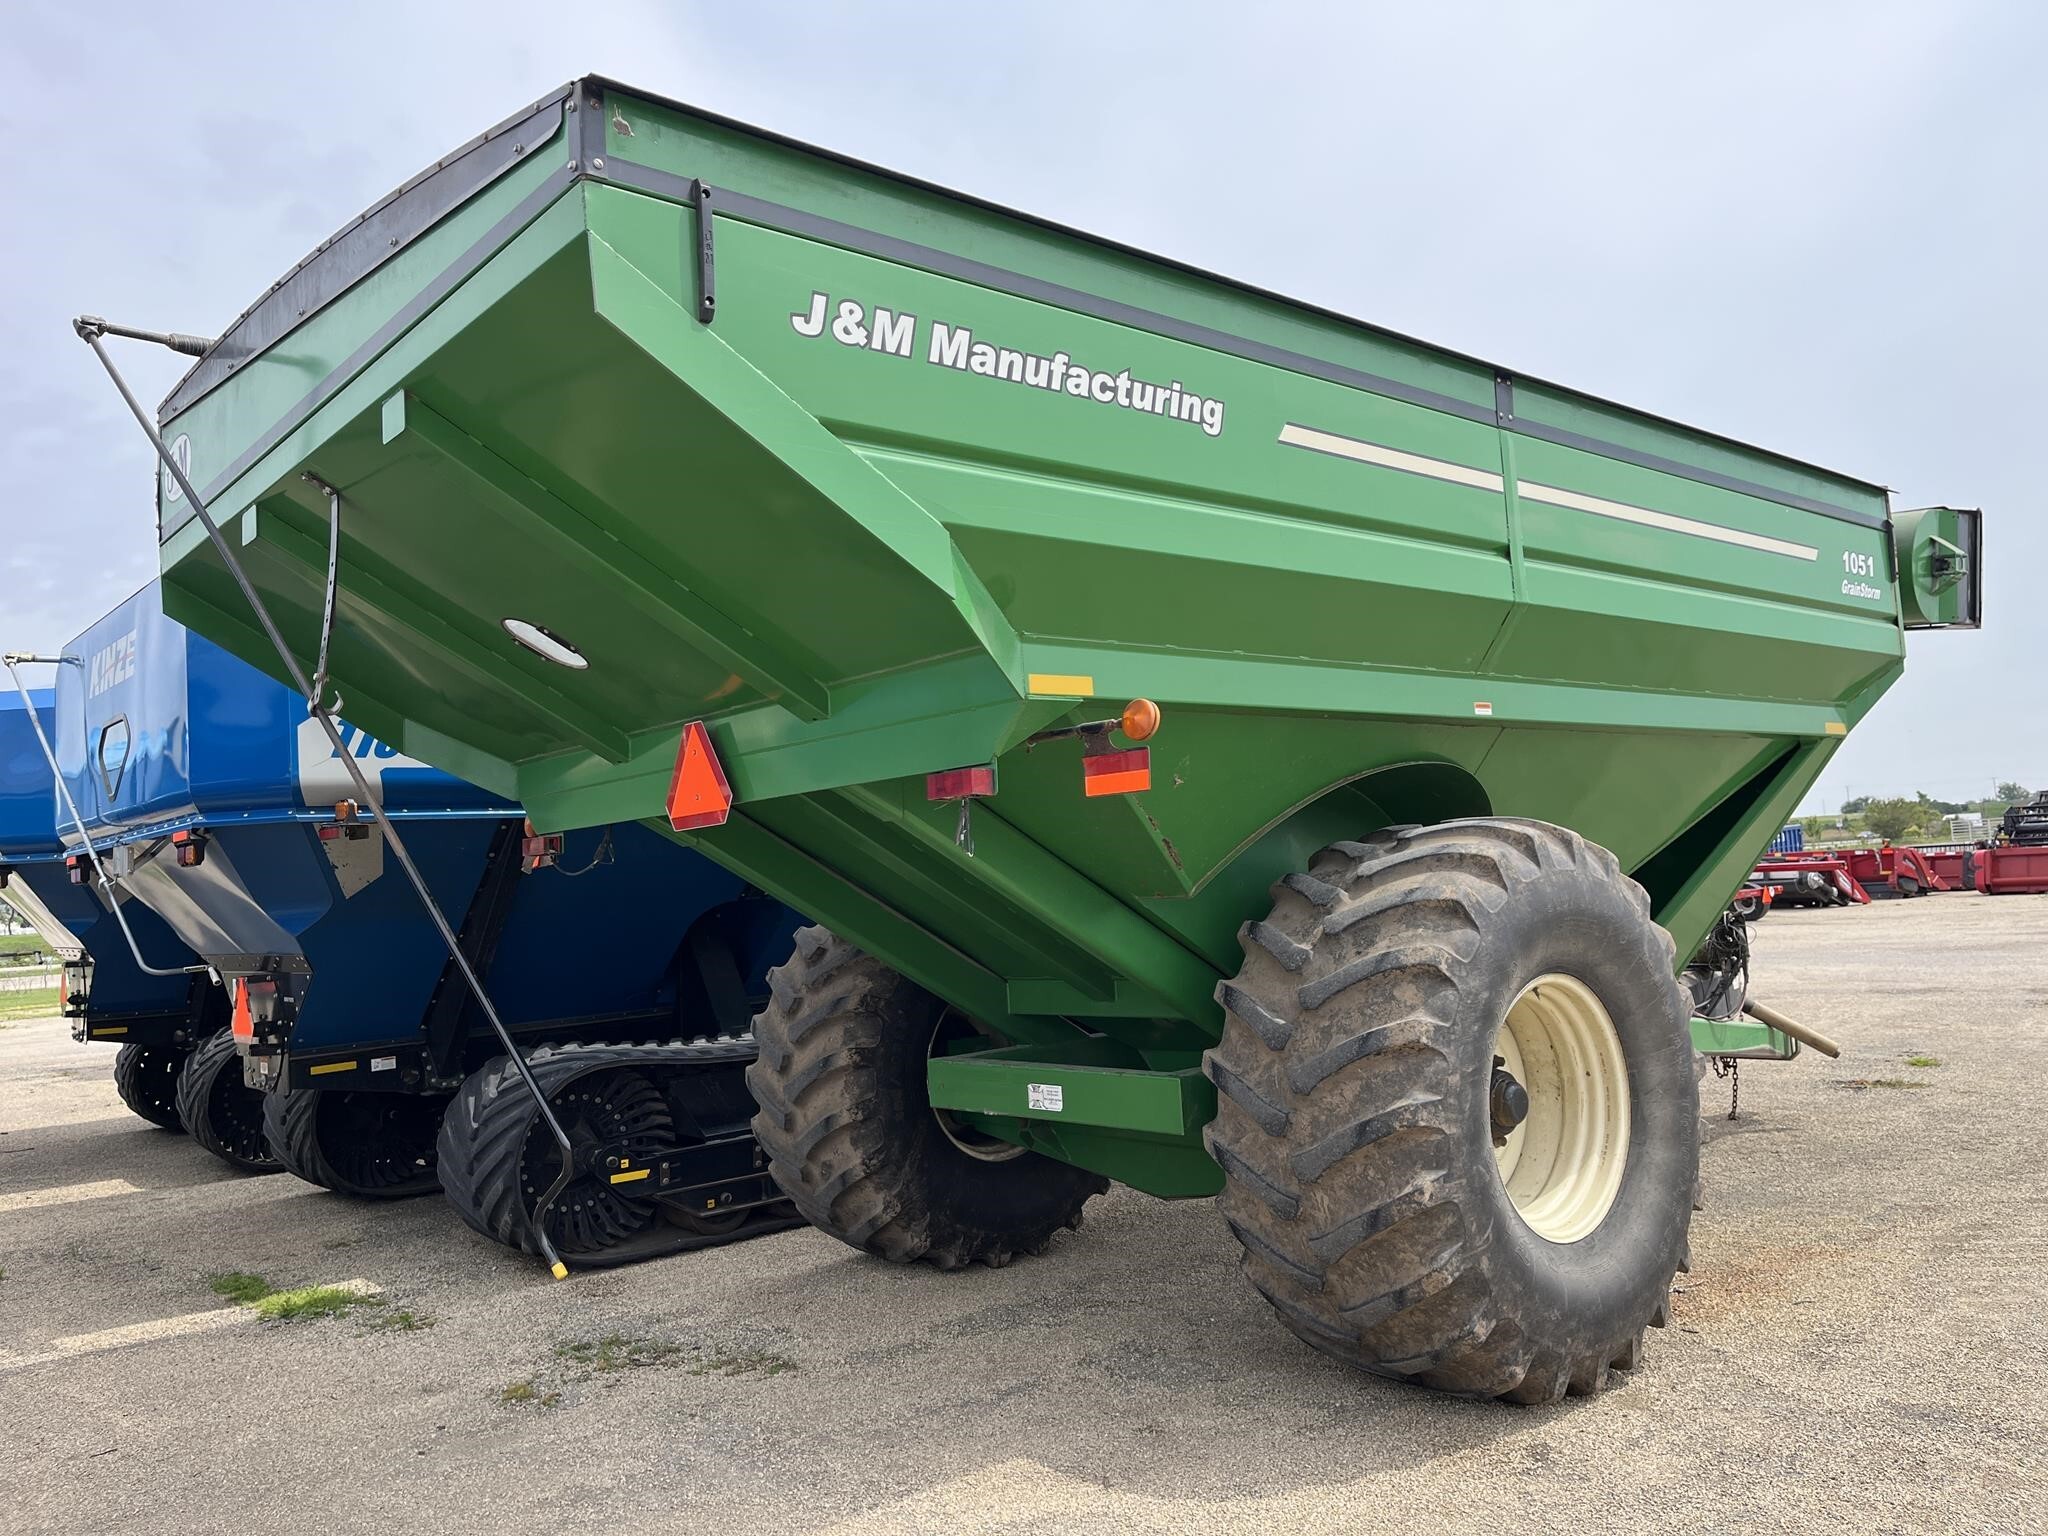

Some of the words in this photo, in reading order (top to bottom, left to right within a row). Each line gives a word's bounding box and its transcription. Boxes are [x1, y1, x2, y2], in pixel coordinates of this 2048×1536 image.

[790, 291, 917, 358] J&M
[927, 320, 1224, 437] Manufacturing
[1843, 551, 1874, 577] 1051
[1842, 580, 1881, 600] GrainStorm
[89, 628, 137, 700] KINZE
